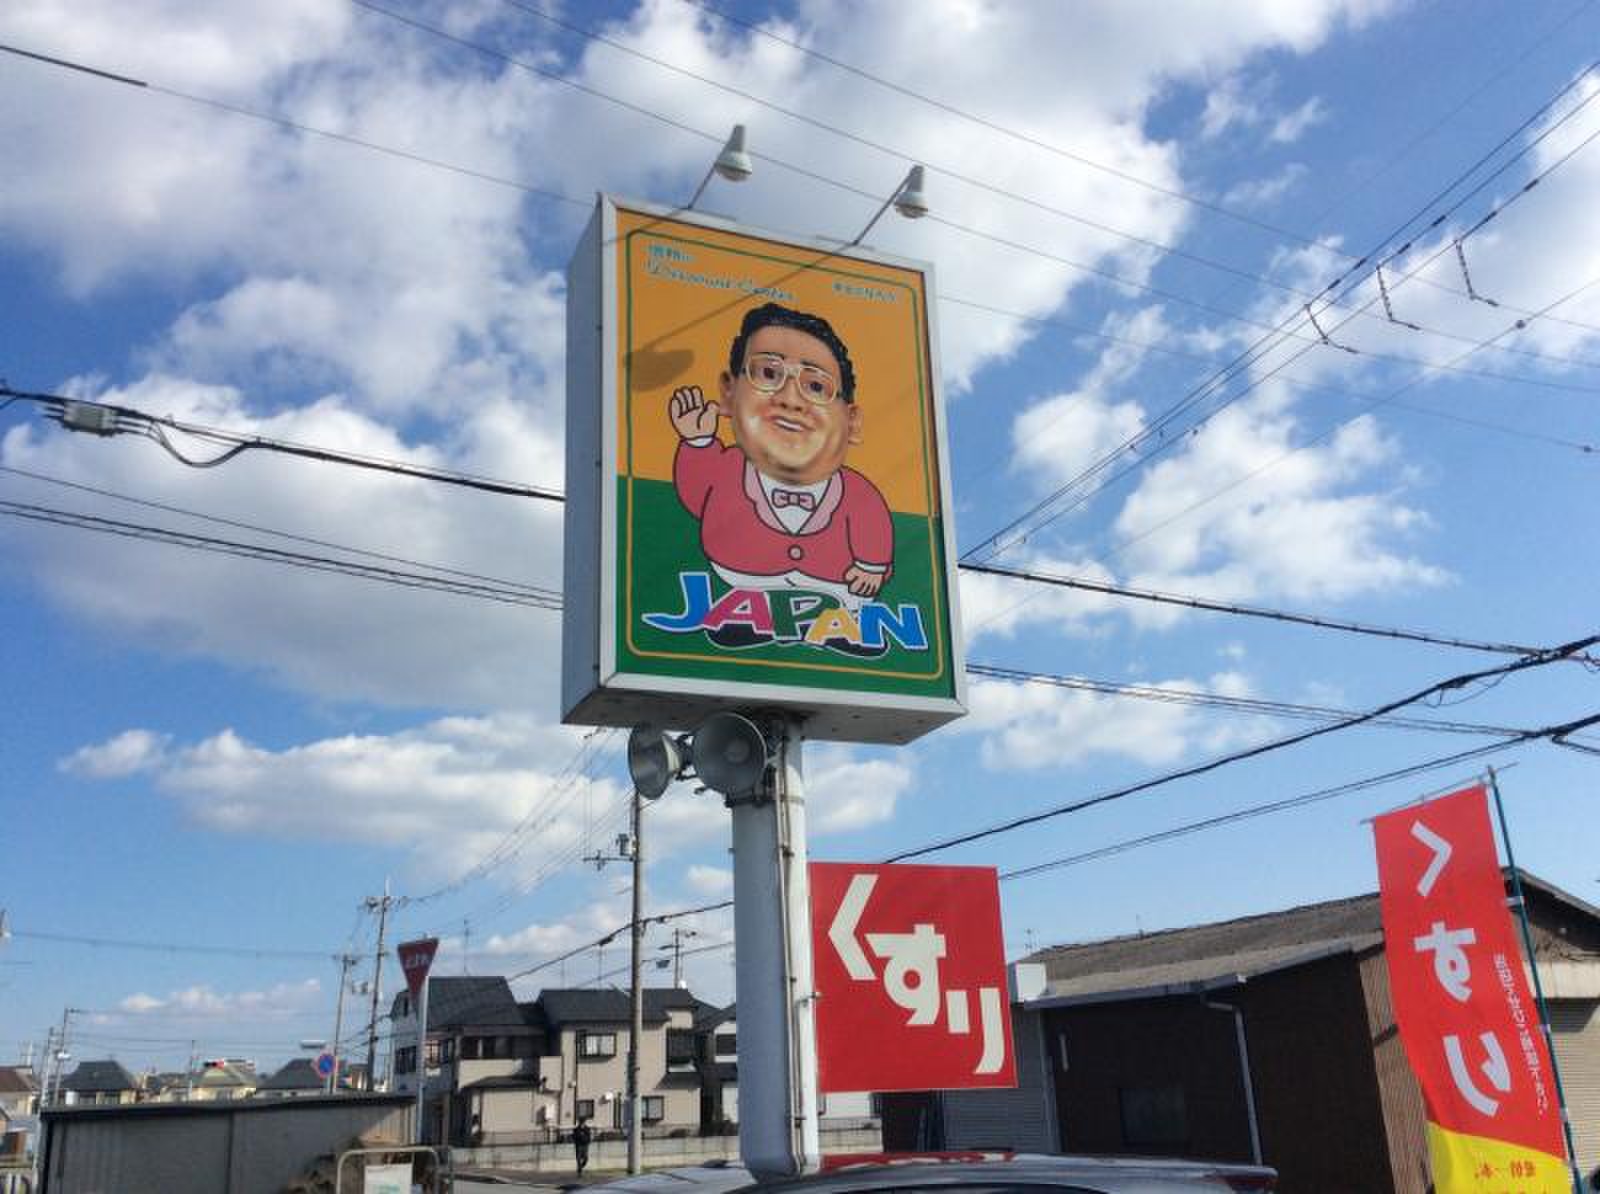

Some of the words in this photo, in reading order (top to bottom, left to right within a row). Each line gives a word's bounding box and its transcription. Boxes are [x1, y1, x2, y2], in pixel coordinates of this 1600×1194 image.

[641, 571, 928, 649] JAPAN
[828, 873, 1005, 1074] くすり
